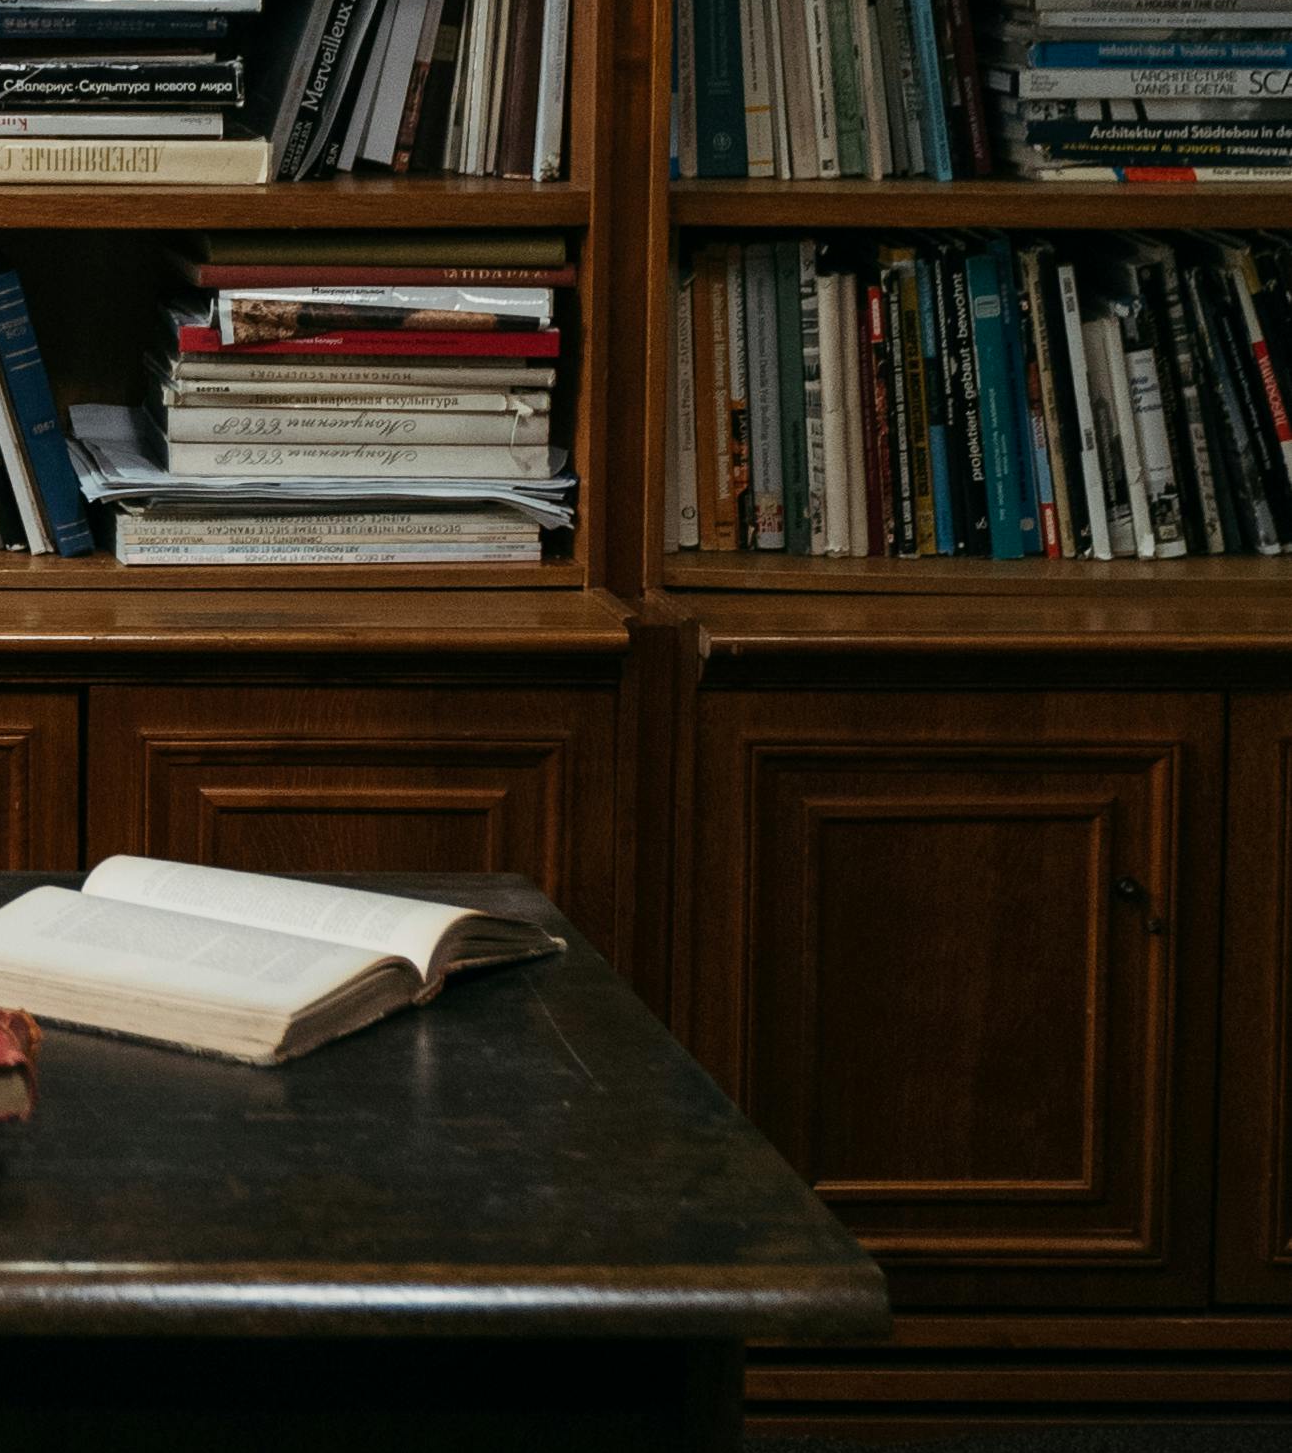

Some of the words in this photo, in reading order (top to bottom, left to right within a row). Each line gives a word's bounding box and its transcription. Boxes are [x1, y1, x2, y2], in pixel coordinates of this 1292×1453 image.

[299, 1, 353, 111] Merveilleux
[154, 81, 195, 90] нового
[200, 81, 232, 92] мира
[326, 143, 340, 165] SUN
[1090, 124, 1162, 138] Architektur
[1164, 124, 1187, 139] und
[1191, 124, 1257, 139] Städtebau
[1261, 125, 1272, 139] in
[950, 272, 969, 337] bewohnt
[957, 346, 976, 398] gebaut
[964, 409, 985, 481] projektiert
